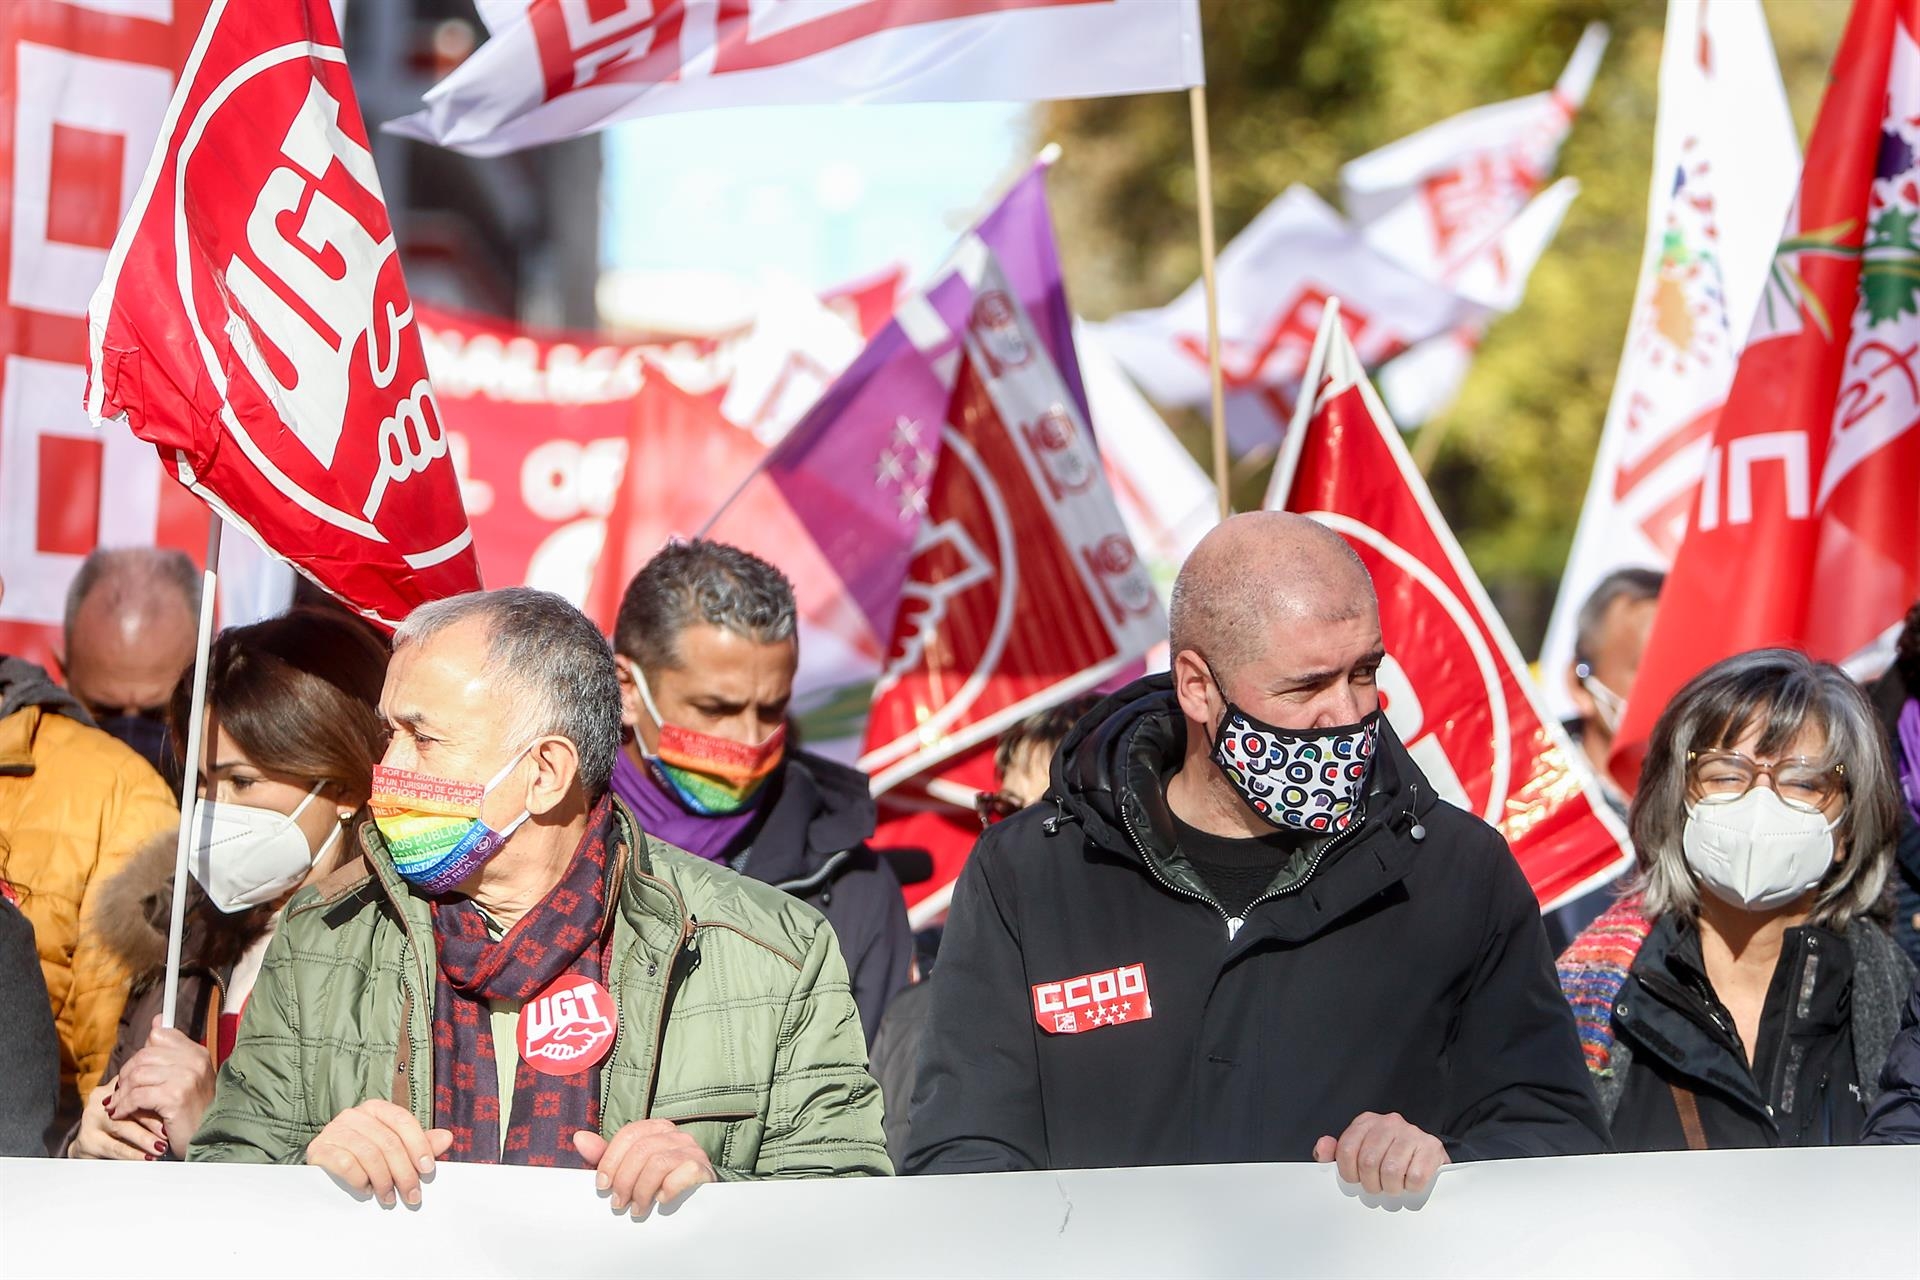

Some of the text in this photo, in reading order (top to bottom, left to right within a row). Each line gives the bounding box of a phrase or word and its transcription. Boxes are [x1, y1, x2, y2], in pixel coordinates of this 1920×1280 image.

[225, 75, 398, 470] UGT
[382, 768, 400, 777] POR
[401, 771, 412, 779] LA
[413, 773, 457, 786] IGUALDAD
[386, 778, 398, 787] UN
[399, 780, 433, 793] TURISMO
[435, 785, 447, 794] DE
[447, 788, 483, 799] CALIDAD
[420, 791, 482, 807] PUBLICOS
[415, 820, 475, 848] PUBLICOS
[445, 823, 485, 864] SOSTENIBLE
[437, 853, 470, 879] CALIDAD
[452, 860, 478, 879] REAL
[1036, 966, 1145, 1013] CCOO
[527, 982, 598, 1040] UGT
